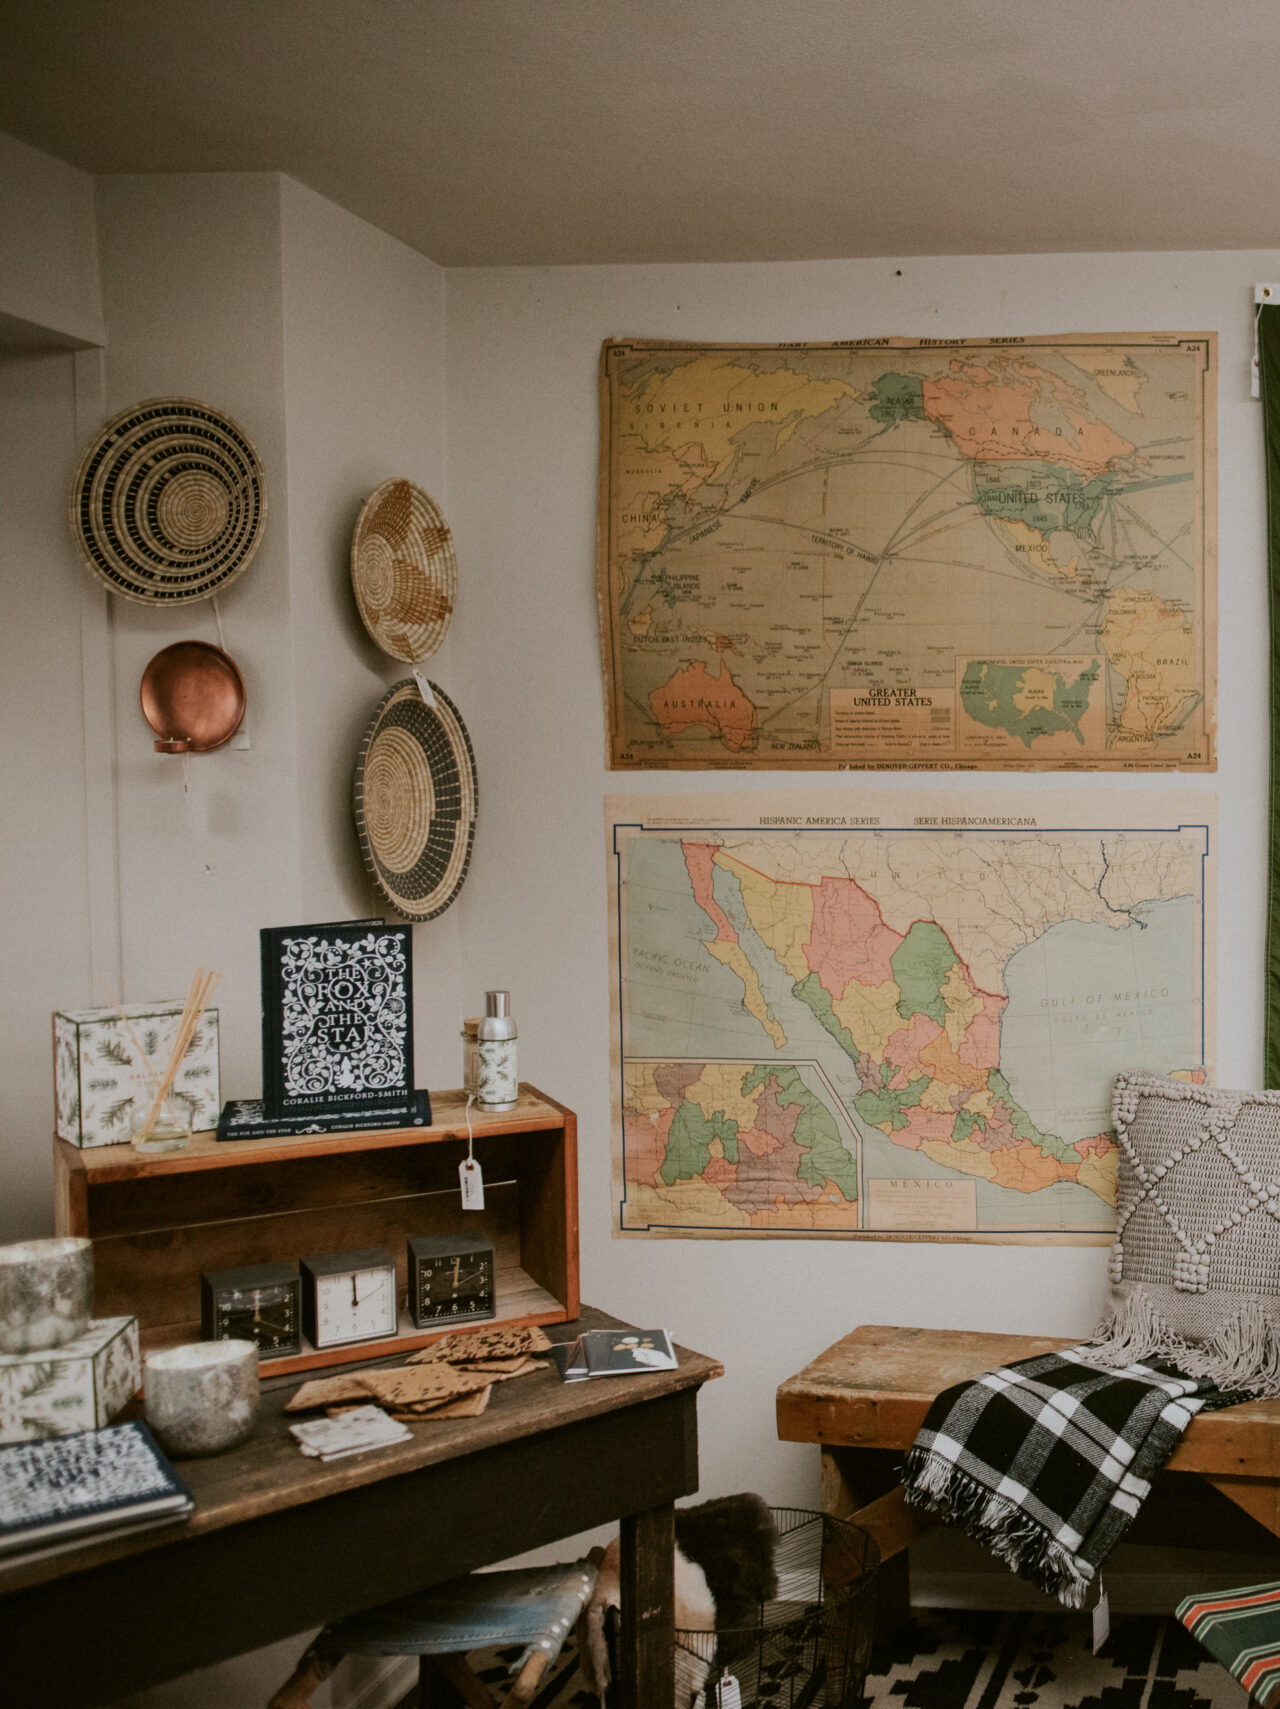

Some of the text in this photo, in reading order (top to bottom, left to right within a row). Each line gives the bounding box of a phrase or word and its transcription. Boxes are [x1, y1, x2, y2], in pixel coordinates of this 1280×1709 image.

[832, 338, 890, 347] AMERICAN
[919, 338, 967, 346] HISTORY
[989, 336, 1026, 345] SERIES
[1186, 345, 1201, 353] A24
[1093, 369, 1134, 377] GREENLAND
[634, 401, 779, 415] SOVIET UNION
[629, 420, 732, 430] SIBERIA
[968, 426, 1085, 437] CANADA
[999, 492, 1086, 504] UNITED STATES
[621, 513, 658, 524] CHINA
[688, 520, 724, 545] JAPANESE
[810, 534, 845, 552] TERRITORY
[1015, 543, 1049, 553] MEXICO
[1108, 608, 1138, 616] COLOMBIA
[1156, 657, 1190, 667] BRAZIL
[868, 688, 918, 699] GREATER
[663, 699, 736, 710] AUSTRALIA
[852, 696, 934, 708] UNITED STATES
[1117, 734, 1156, 744] ARGENTINA
[770, 742, 786, 751] NEW
[619, 752, 634, 761] A24
[1187, 751, 1201, 760] A24
[876, 762, 938, 770] DENOYER-GEPPERT
[954, 763, 978, 771] Chicago
[759, 816, 880, 826] HISPANIC AMERICA SERIES
[913, 816, 1037, 827] SERIE HISPANOAMERICANA
[870, 864, 1137, 882] UNITED STATES
[633, 948, 711, 974] PACIFIC OCEAN
[326, 969, 362, 980] THE
[317, 981, 371, 1000] FOX
[1040, 988, 1170, 1009] GULF OF MEXICO
[324, 1000, 366, 1012] AND
[328, 1013, 363, 1026] THE
[317, 1026, 376, 1043] STAR
[282, 1088, 409, 1106] CORALIE BICKFORD-SMITH
[889, 1179, 954, 1189] MEXICO
[435, 1259, 442, 1267] 11
[479, 1262, 485, 1270] 2
[423, 1269, 433, 1278] 10
[479, 1276, 485, 1284] 3
[424, 1283, 431, 1291] 9
[283, 1294, 290, 1303] 2
[424, 1297, 431, 1306] 8
[222, 1303, 232, 1312] 10
[436, 1305, 442, 1314] 7
[452, 1303, 458, 1311] 6
[469, 1301, 476, 1309] 5
[283, 1309, 290, 1318] 3
[222, 1318, 230, 1327] 9
[283, 1324, 290, 1332] 4
[272, 1336, 280, 1344] 5
